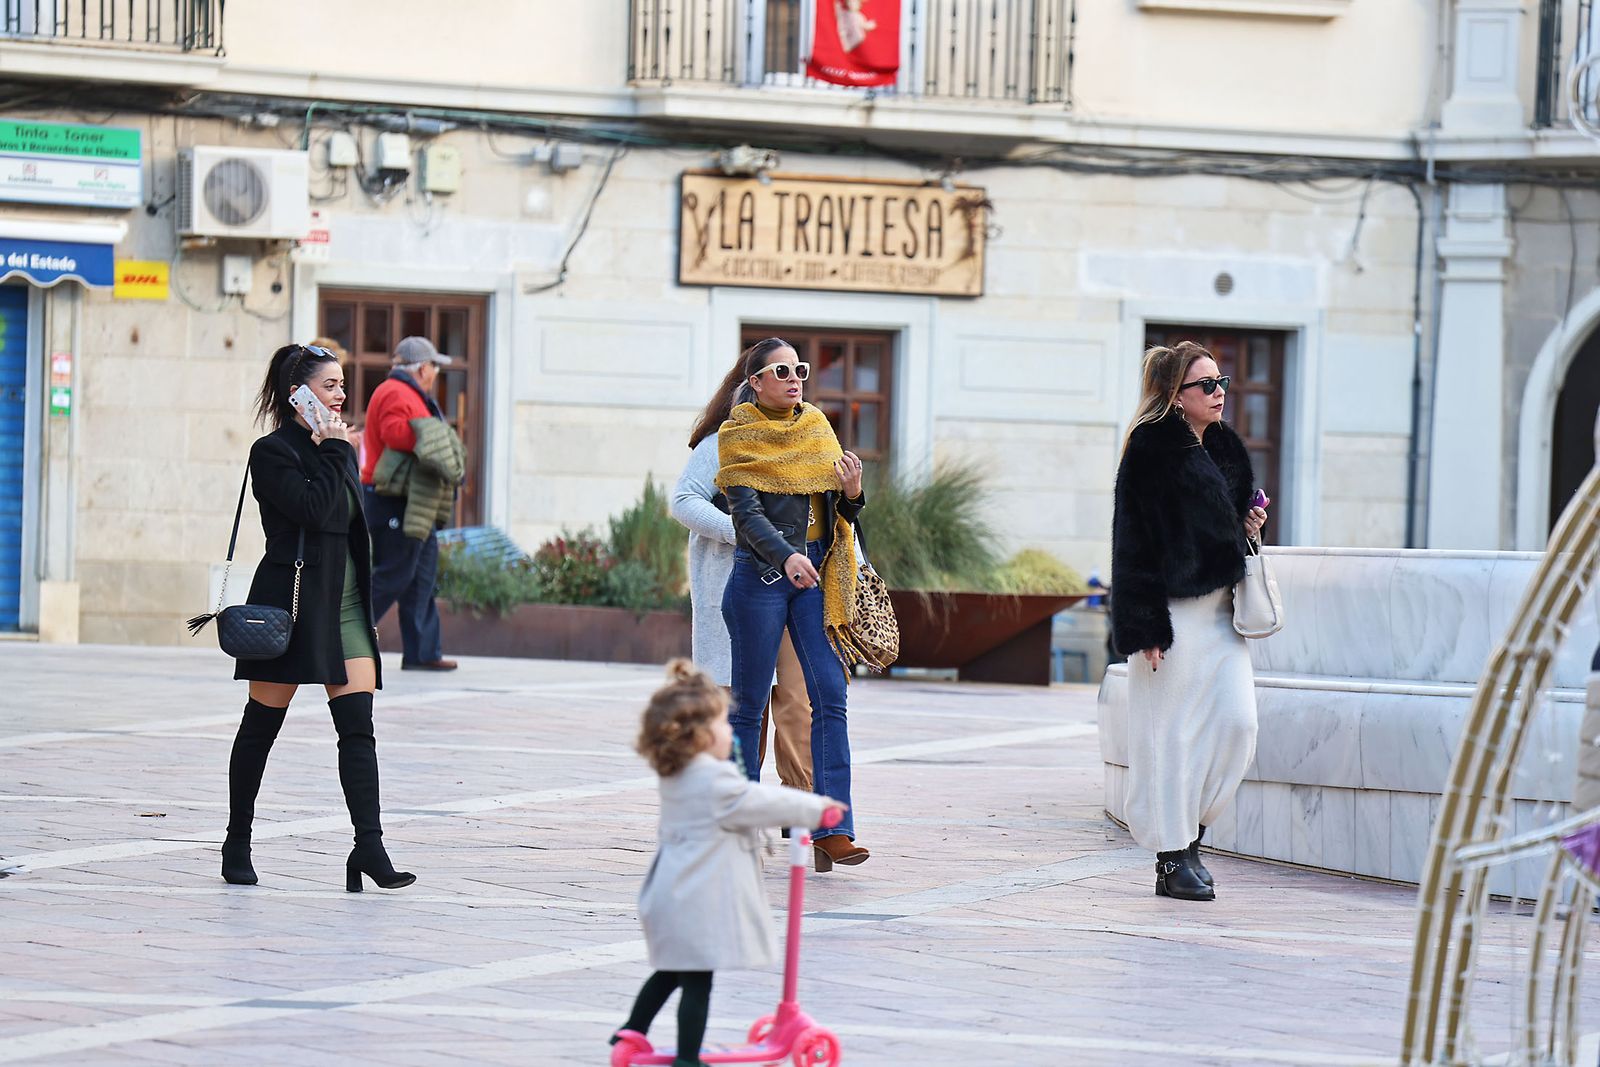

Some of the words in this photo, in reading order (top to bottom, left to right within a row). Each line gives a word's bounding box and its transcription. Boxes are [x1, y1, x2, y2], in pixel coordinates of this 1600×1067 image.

[15, 125, 48, 139] Tinta
[65, 128, 105, 143] Toner
[720, 189, 755, 251] LA
[774, 191, 944, 260] TRAVIESA
[8, 252, 28, 268] del
[30, 253, 77, 272] Estado
[123, 274, 159, 285] DHL
